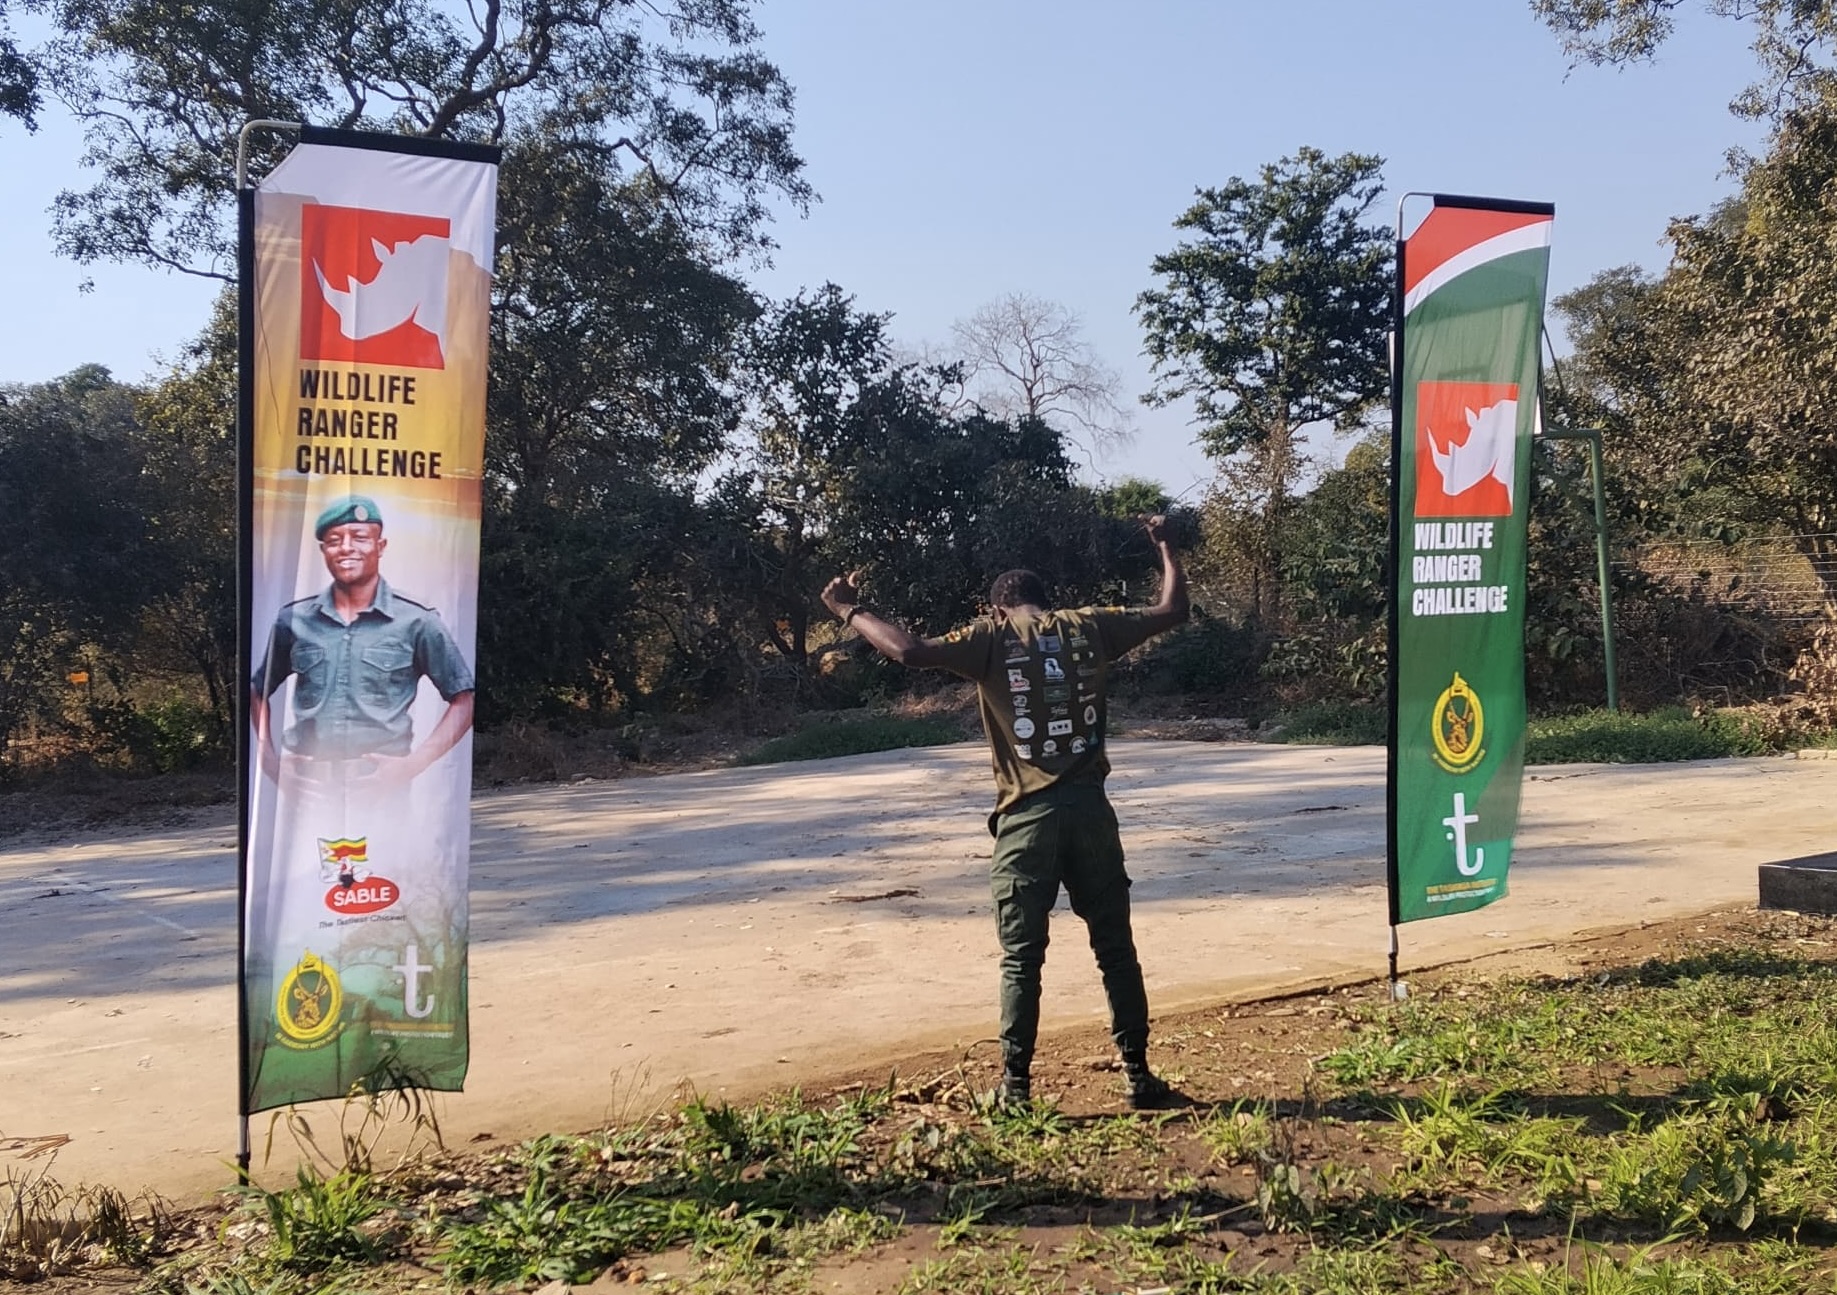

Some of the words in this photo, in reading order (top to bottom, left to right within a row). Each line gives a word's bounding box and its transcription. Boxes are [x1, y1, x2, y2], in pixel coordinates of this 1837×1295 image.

[300, 369, 416, 405] WILDLIFE
[297, 407, 398, 441] RANGER
[296, 444, 442, 480] CHALLENGE
[1414, 522, 1494, 551] WILDLIFE
[1412, 555, 1482, 584] RANGER
[1412, 586, 1508, 616] CHALLENGE
[333, 886, 391, 907] SABLE
